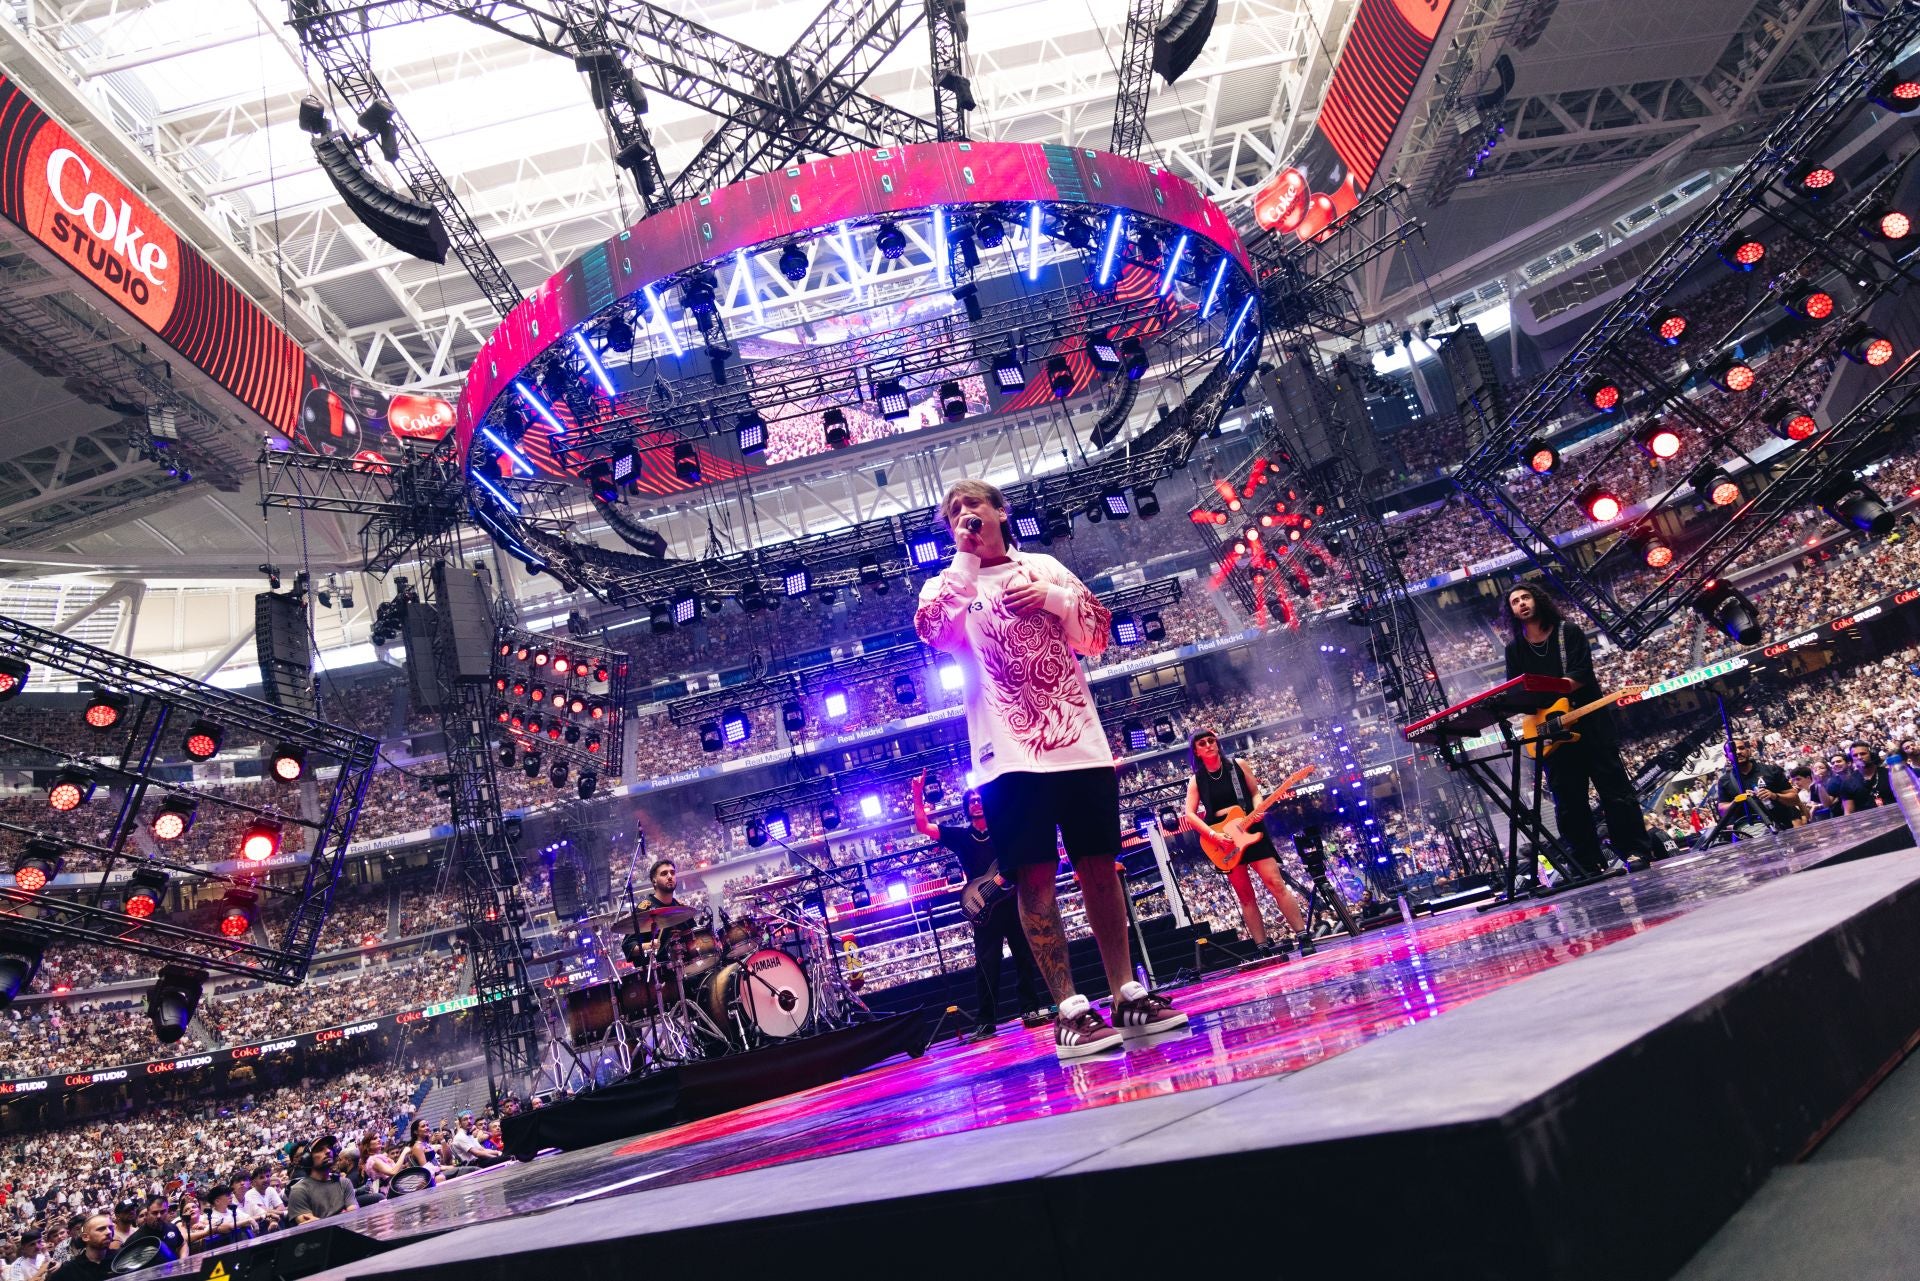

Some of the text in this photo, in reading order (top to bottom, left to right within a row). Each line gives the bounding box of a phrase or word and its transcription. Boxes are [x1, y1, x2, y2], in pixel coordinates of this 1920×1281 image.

[1268, 184, 1297, 222] Coke
[47, 148, 168, 285] Coke
[51, 212, 148, 305] STUDIO
[400, 413, 442, 432] Coke
[1572, 526, 1592, 538] Real
[1474, 562, 1492, 573] Real
[1894, 590, 1918, 604] Coke
[1832, 606, 1881, 630] Coke STUDIO
[1197, 633, 1243, 651] Real Madrid
[1764, 632, 1818, 657] Coke STUDIO
[1108, 659, 1154, 676] Real Madrid
[1616, 694, 1642, 706] Coke
[928, 708, 964, 722] Real Mad
[838, 727, 884, 744] Real Madrid
[745, 756, 763, 767] Real
[652, 770, 700, 788] Real Madrid
[1363, 765, 1392, 777] STUDIO
[1296, 783, 1324, 795] STUDIO
[350, 836, 405, 854] Real Madrid
[236, 855, 295, 869] Real Madrid
[115, 874, 134, 882] Rea
[616, 960, 634, 971] Cok
[751, 956, 781, 972] YAMAHA
[396, 1011, 421, 1024] Coke
[316, 1022, 378, 1041] Coke STUDIO
[232, 1039, 296, 1058] Coke STUDIO
[146, 1056, 212, 1074] Coke STUDIO
[65, 1070, 127, 1086] Coke STUDIO
[0, 1081, 47, 1093] oke STUDIO
